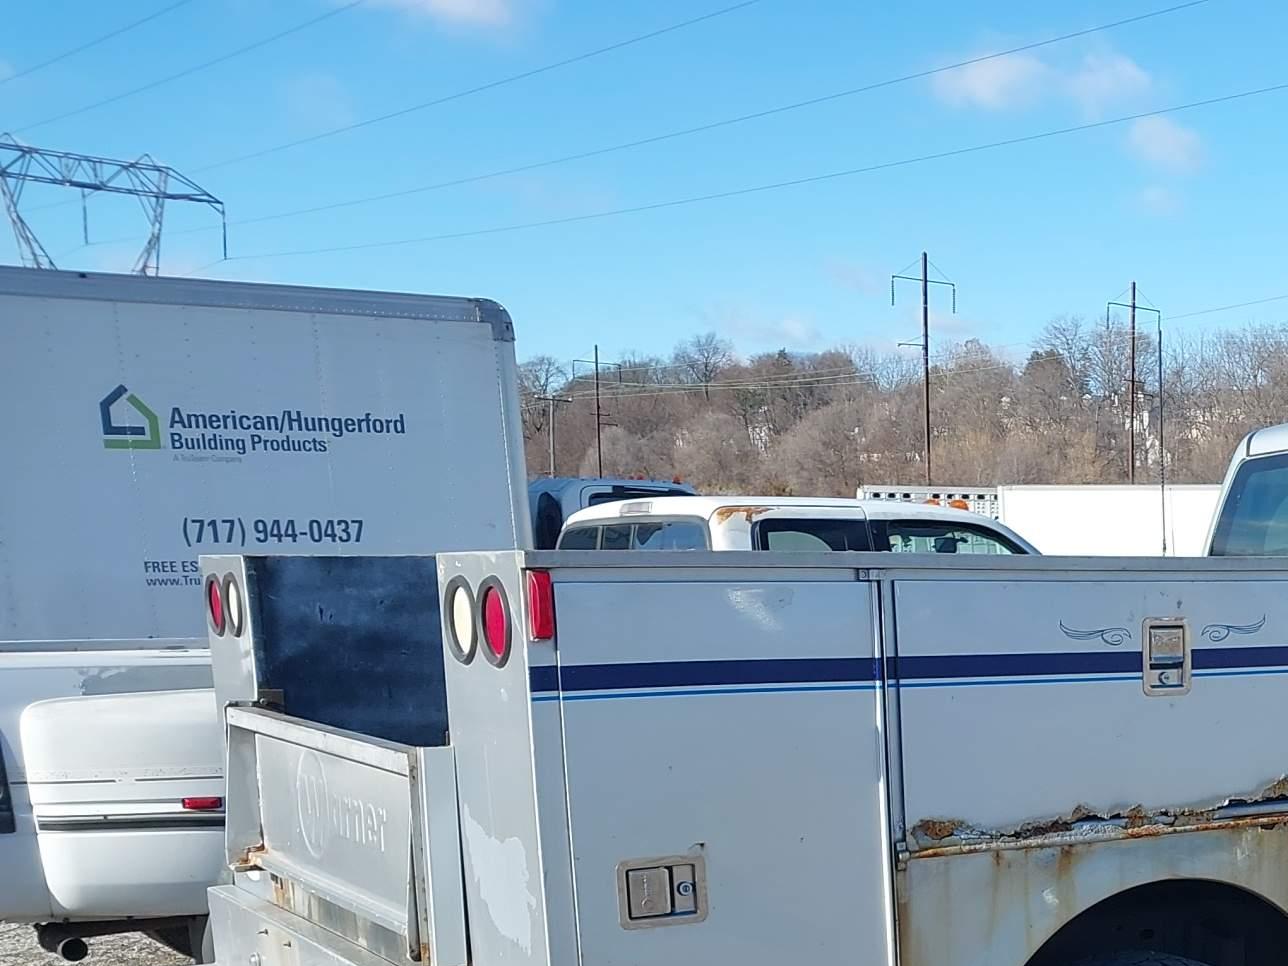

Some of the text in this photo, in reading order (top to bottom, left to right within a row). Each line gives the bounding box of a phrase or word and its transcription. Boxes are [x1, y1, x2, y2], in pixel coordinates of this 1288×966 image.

[169, 407, 406, 437] American/Hungerford
[170, 432, 328, 455] Building Products
[182, 517, 364, 547] (717) 944-0437
[144, 560, 199, 573] FREE ES
[146, 575, 201, 586] www.Tru
